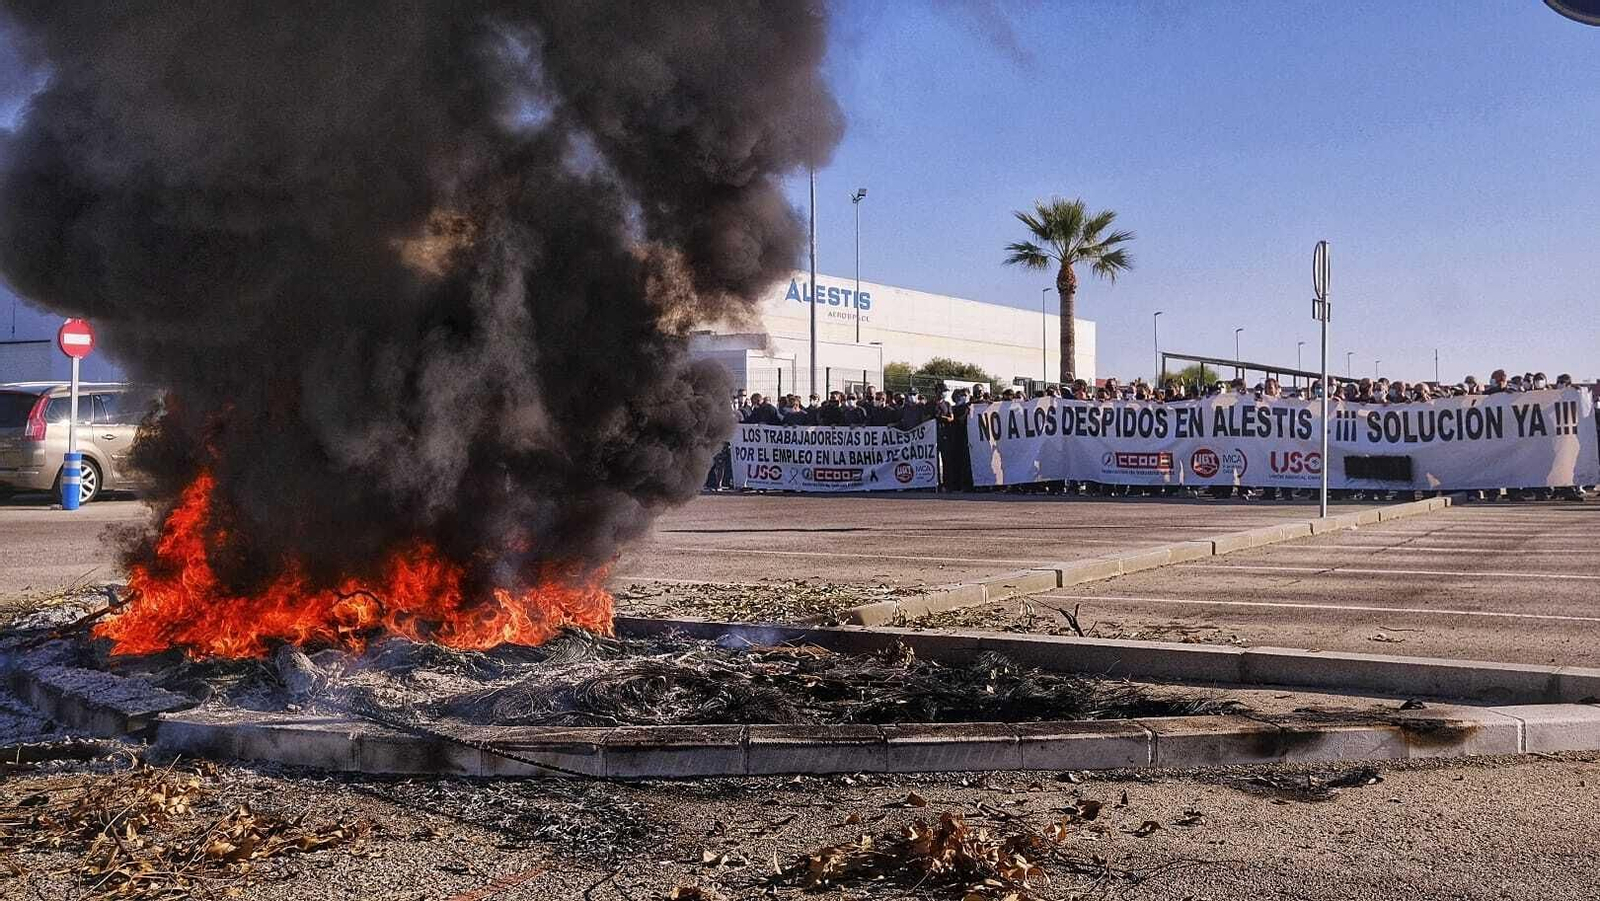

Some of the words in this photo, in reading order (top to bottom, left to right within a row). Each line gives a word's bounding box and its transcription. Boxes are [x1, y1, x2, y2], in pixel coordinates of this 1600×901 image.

[785, 278, 871, 310] ALESTIS
[978, 411, 1001, 441] NO
[1008, 410, 1020, 439] A
[1024, 405, 1058, 438] LOS
[1062, 405, 1168, 439] DESPIDOS
[1175, 407, 1204, 438] EN
[1212, 405, 1313, 440] ALESTIS
[1366, 399, 1503, 443] SOLUCIÓN
[1512, 403, 1548, 437] YA
[1554, 401, 1578, 435] !!!
[742, 428, 761, 443] LOS
[765, 428, 861, 446] TRABAJADORES/AS
[864, 430, 878, 446] DE
[881, 426, 926, 445] ALESTIS
[735, 447, 754, 462] POR
[757, 447, 770, 462] EL
[772, 449, 812, 464] EMPLEO
[815, 450, 829, 465] EN
[833, 451, 846, 465] LA
[849, 447, 883, 466] BAHÍA
